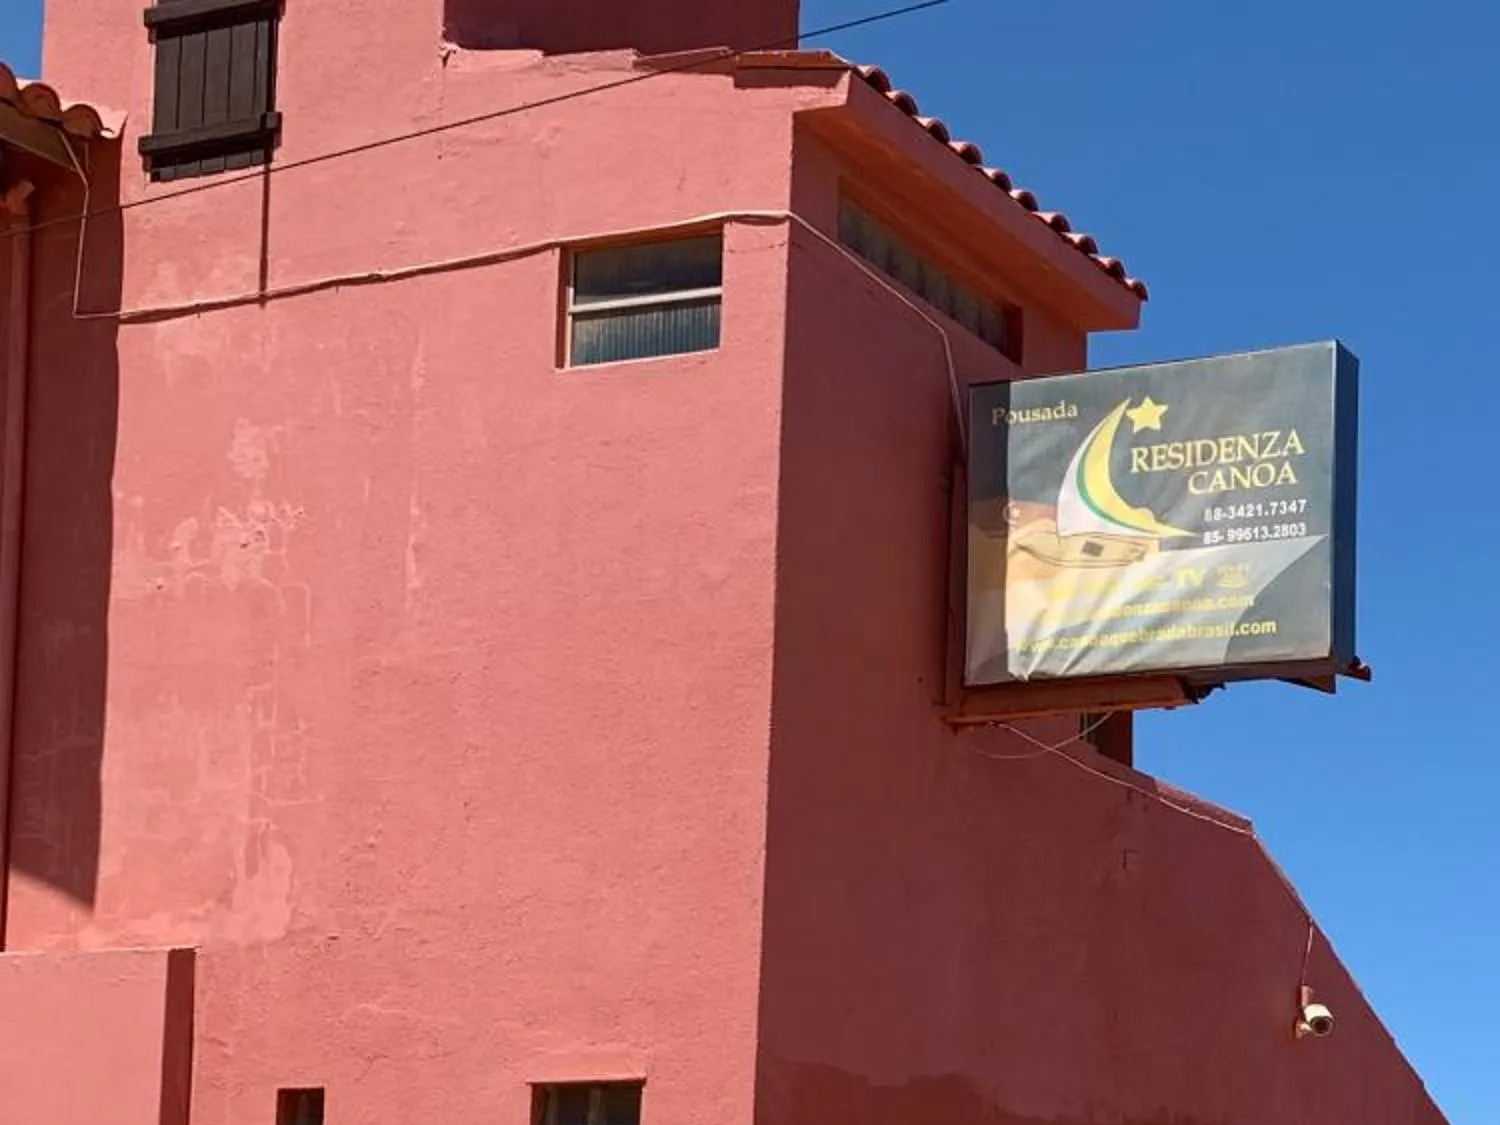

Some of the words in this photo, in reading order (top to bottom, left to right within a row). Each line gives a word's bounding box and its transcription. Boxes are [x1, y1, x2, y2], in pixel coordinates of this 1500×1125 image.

[991, 400, 1078, 425] Pousada
[1130, 429, 1305, 474] RESIDENZA
[1188, 462, 1298, 496] CANOA
